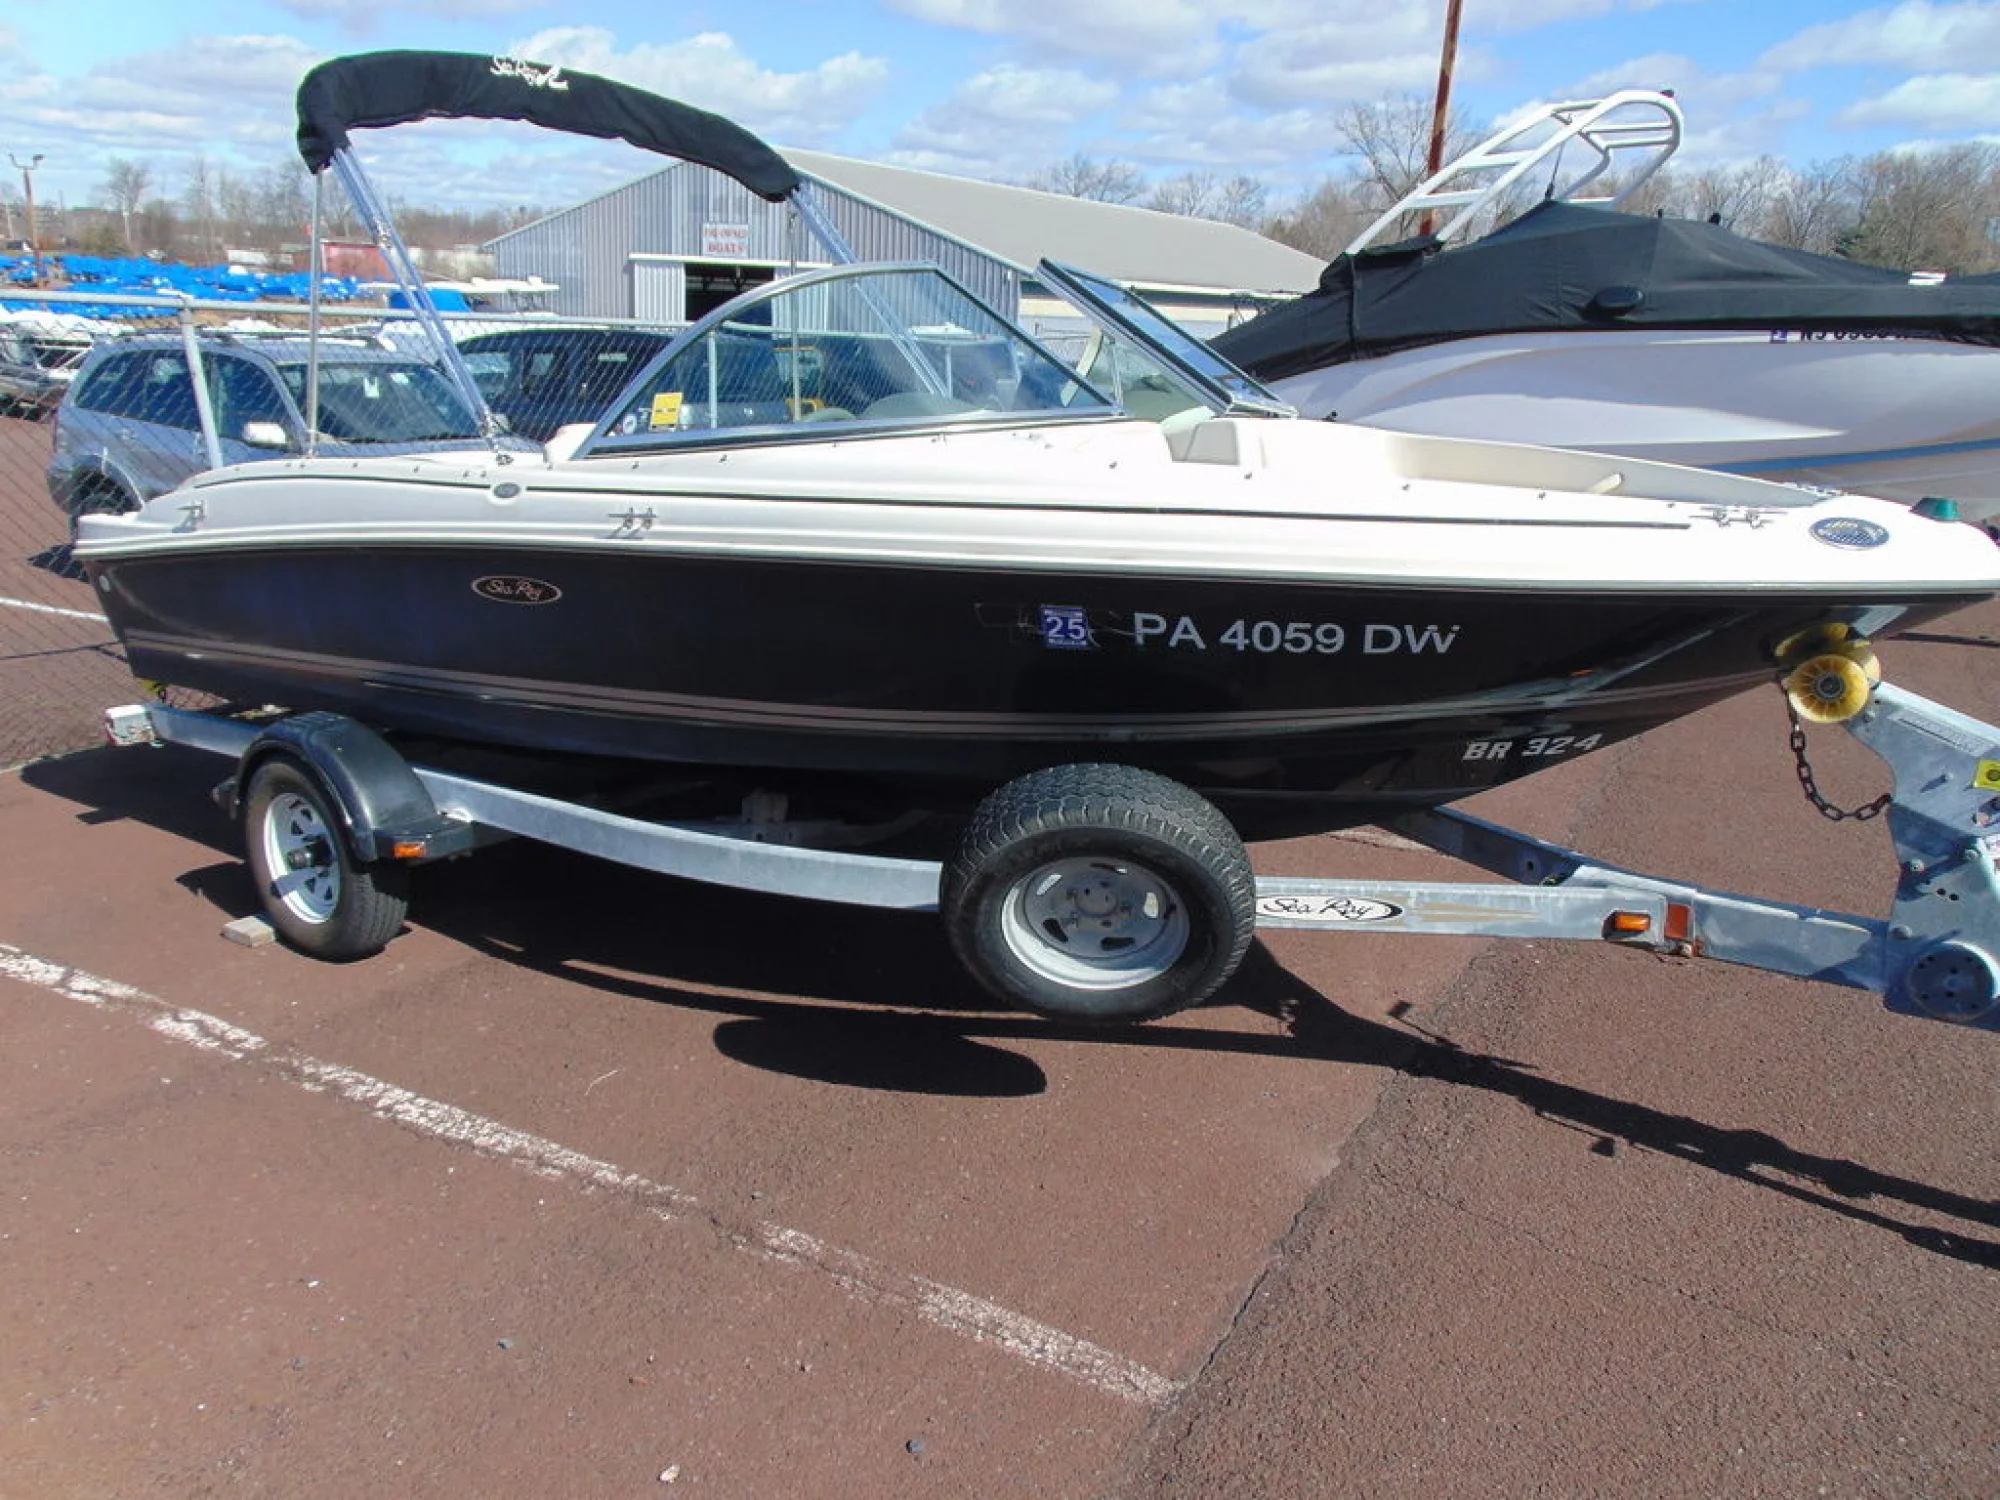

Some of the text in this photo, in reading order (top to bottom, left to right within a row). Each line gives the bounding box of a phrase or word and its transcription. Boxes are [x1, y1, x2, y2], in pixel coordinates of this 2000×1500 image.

[1046, 616, 1085, 640] 25
[1133, 612, 1460, 654] PA 4059 DW
[1462, 733, 1602, 761] BR 324
[1263, 897, 1373, 920] Sea Ray
